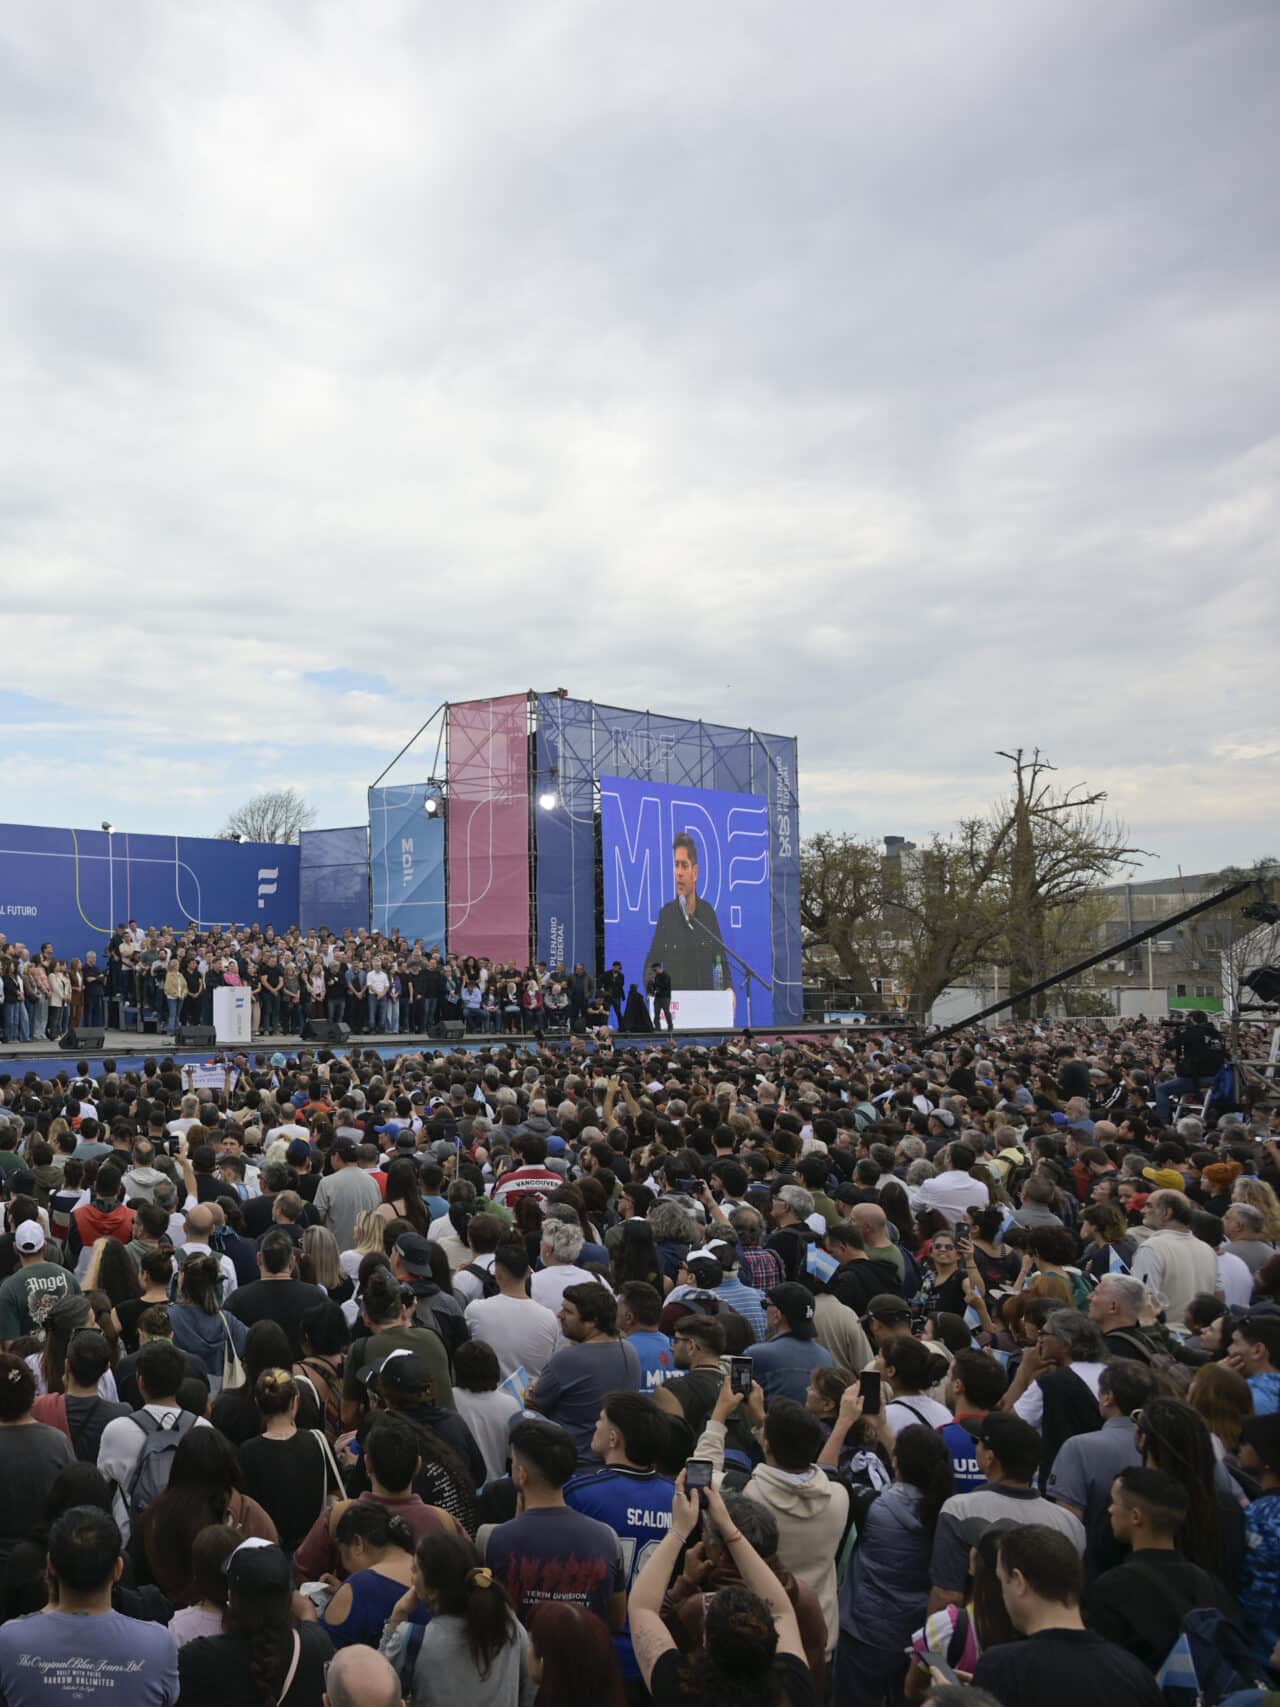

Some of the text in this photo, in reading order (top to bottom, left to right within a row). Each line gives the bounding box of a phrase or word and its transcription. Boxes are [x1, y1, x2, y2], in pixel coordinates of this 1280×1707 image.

[7, 905, 37, 916] FUTURO
[557, 923, 565, 961] EDERAL
[24, 1272, 69, 1294] Angel
[552, 1592, 588, 1601] DIVISION
